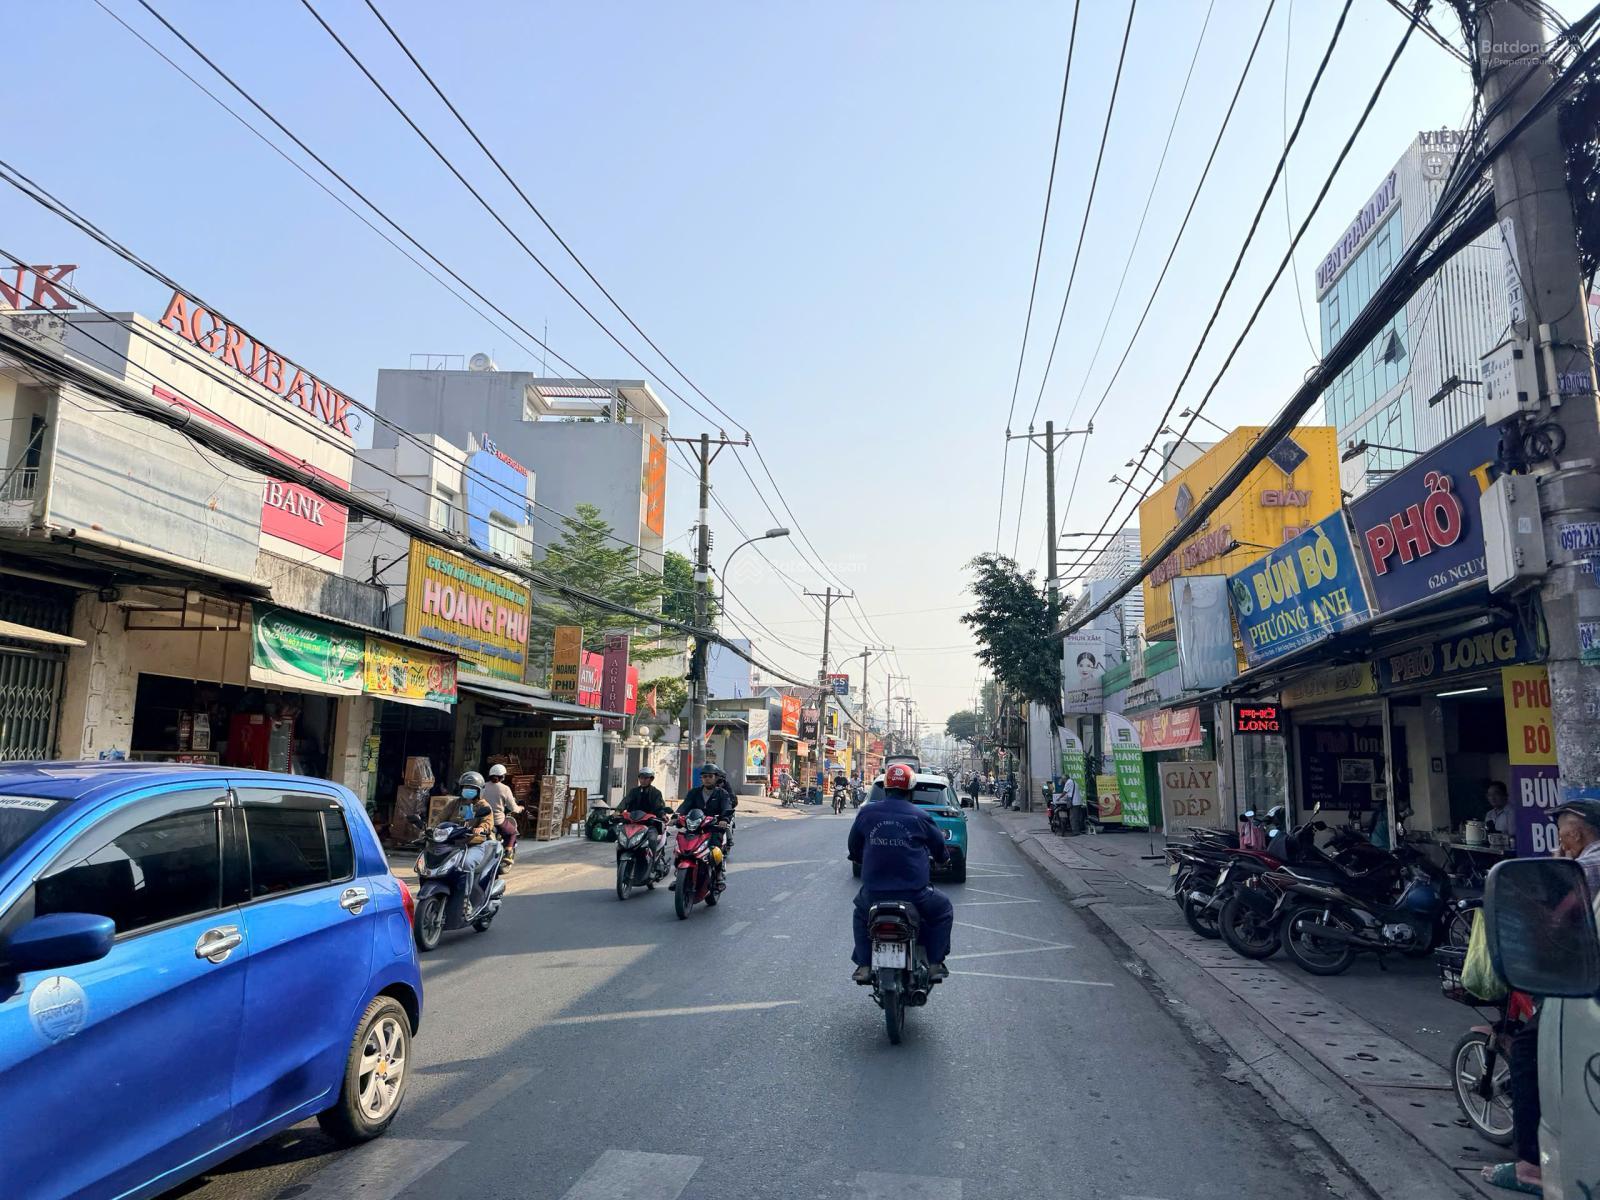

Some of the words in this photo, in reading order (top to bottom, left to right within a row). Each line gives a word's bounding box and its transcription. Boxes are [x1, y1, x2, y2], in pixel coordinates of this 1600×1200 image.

[1341, 208, 1377, 259] THẨM
[158, 289, 353, 439] AGRIBANK
[1365, 471, 1462, 577] PHỞ
[1560, 529, 1583, 551] 0972
[1252, 556, 1301, 611] BÚN
[1299, 526, 1339, 590] BÒ
[1427, 571, 1448, 590] 626
[421, 577, 494, 633] HOÀNG
[1248, 605, 1309, 648] PHƯƠNG
[1311, 587, 1353, 624] ANH
[1442, 627, 1518, 672] LONG
[581, 670, 594, 684] ATM
[1238, 719, 1279, 731] LONG
[1522, 718, 1551, 755] BÒ
[1122, 776, 1141, 786] LAN
[1166, 766, 1213, 789] GIÀY
[1172, 793, 1212, 816] DÉP
[1531, 816, 1559, 853] BÒ
